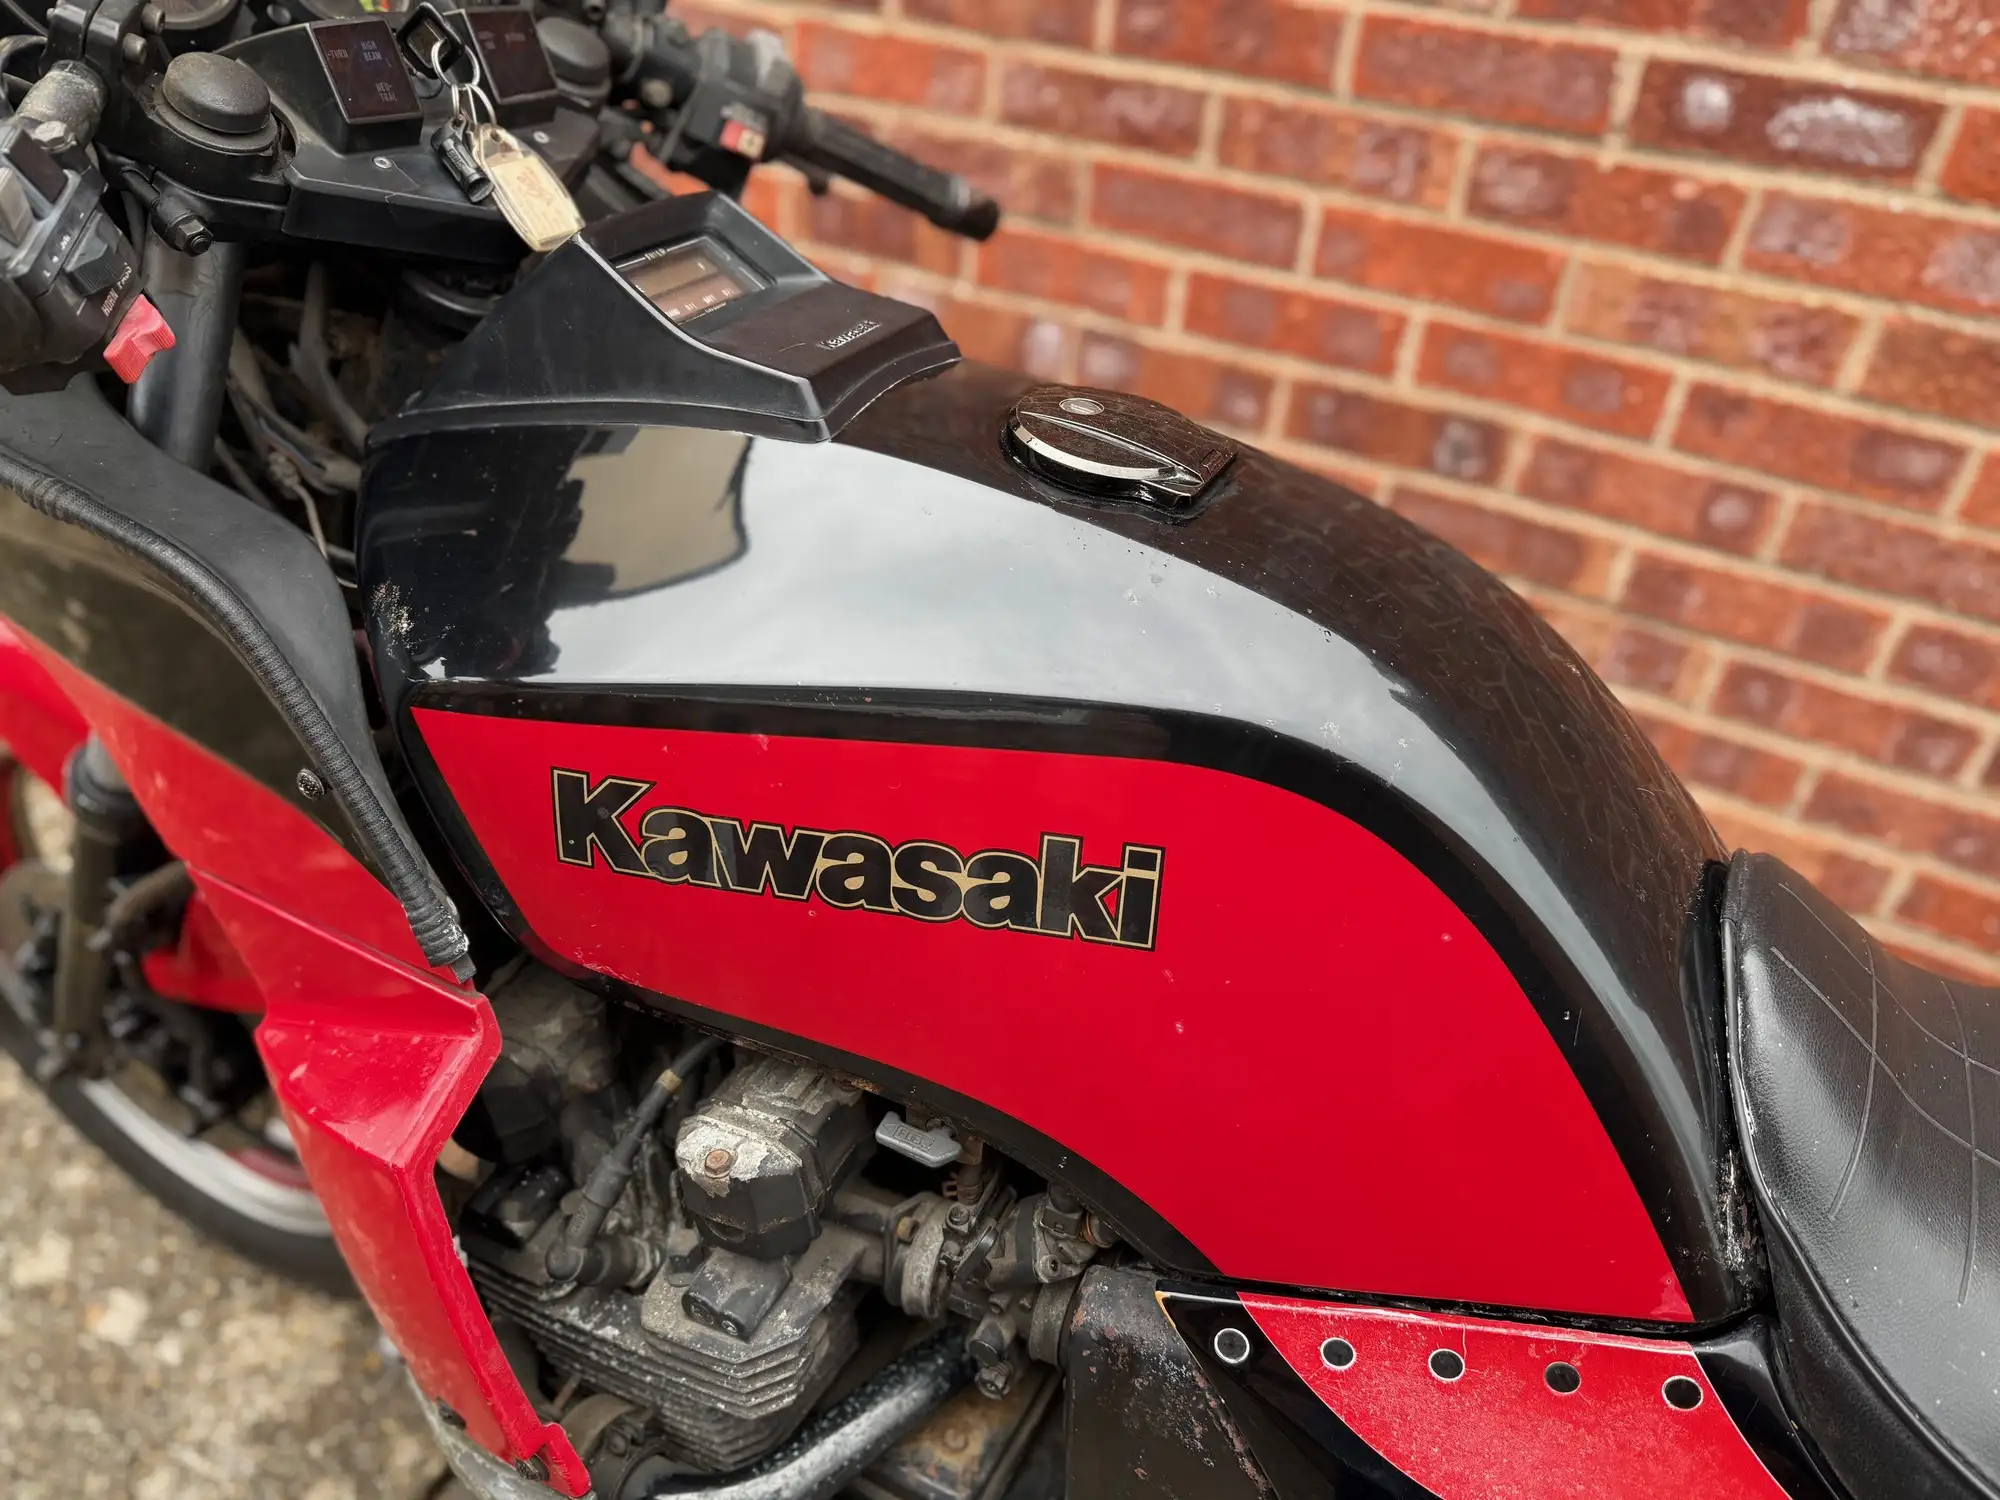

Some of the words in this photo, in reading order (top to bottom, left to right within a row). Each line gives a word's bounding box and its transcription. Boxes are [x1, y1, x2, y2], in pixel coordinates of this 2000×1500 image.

[364, 51, 382, 62] BEAM
[101, 288, 119, 317] HORN
[550, 766, 1165, 952] Kawasaki
